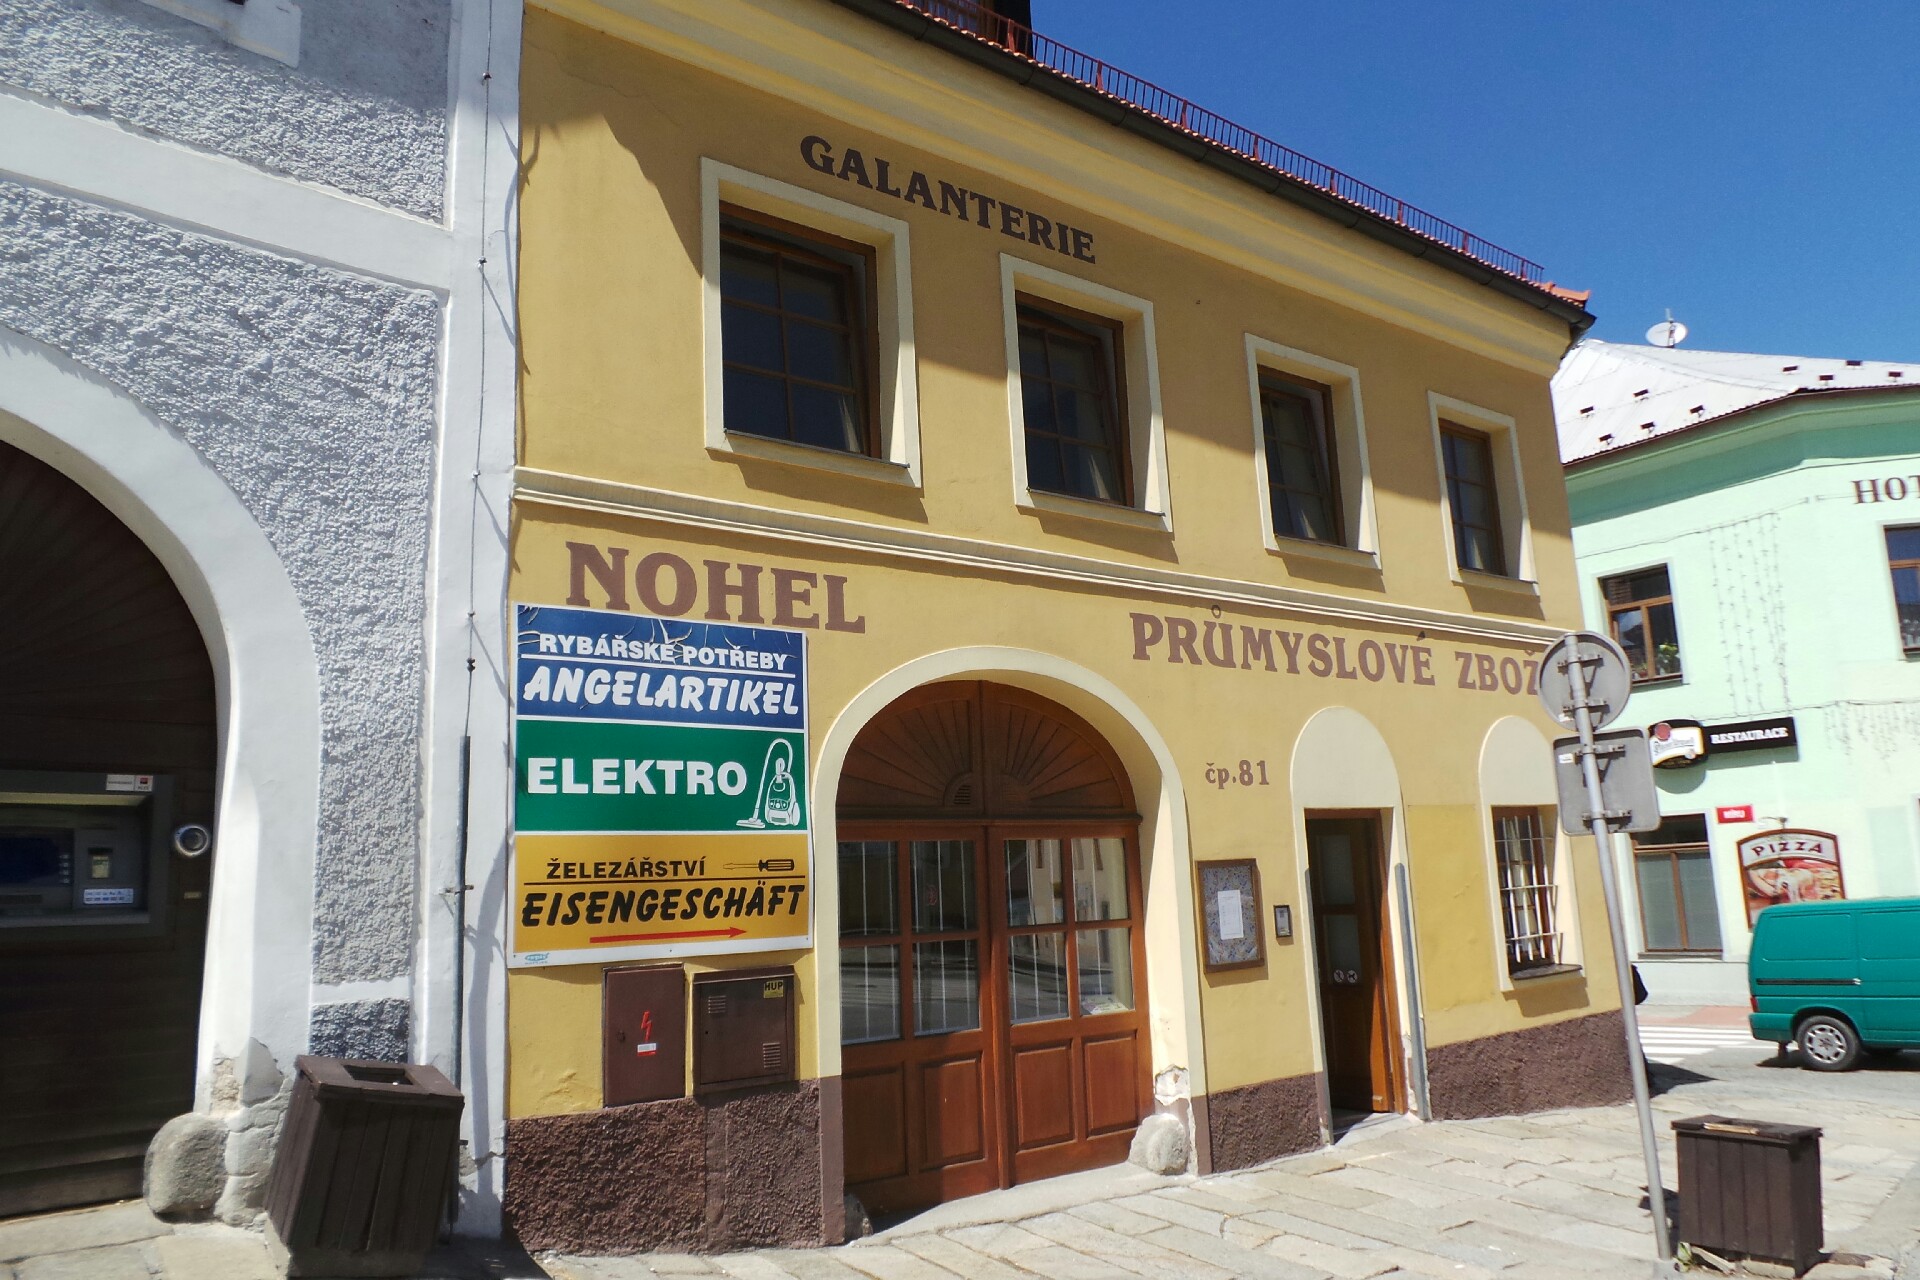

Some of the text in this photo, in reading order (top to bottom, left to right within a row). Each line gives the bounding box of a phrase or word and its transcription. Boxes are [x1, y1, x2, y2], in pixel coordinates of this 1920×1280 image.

[800, 135, 1096, 264] GALANTERIE
[565, 541, 866, 634] NOHEL
[683, 643, 788, 671] POTŘEBY
[1129, 604, 1436, 687] PRŮMYSLOVÉ
[523, 665, 799, 715] ANGELARTIKEL
[1710, 727, 1788, 744] RESTAURACE
[527, 757, 748, 795] ELEKTRO
[546, 856, 706, 880] ŽELEZÁŘSTVÍ
[1751, 842, 1823, 857] PIZZA
[522, 880, 805, 927] EISENGESCHÄFT
[764, 981, 783, 991] HUP
